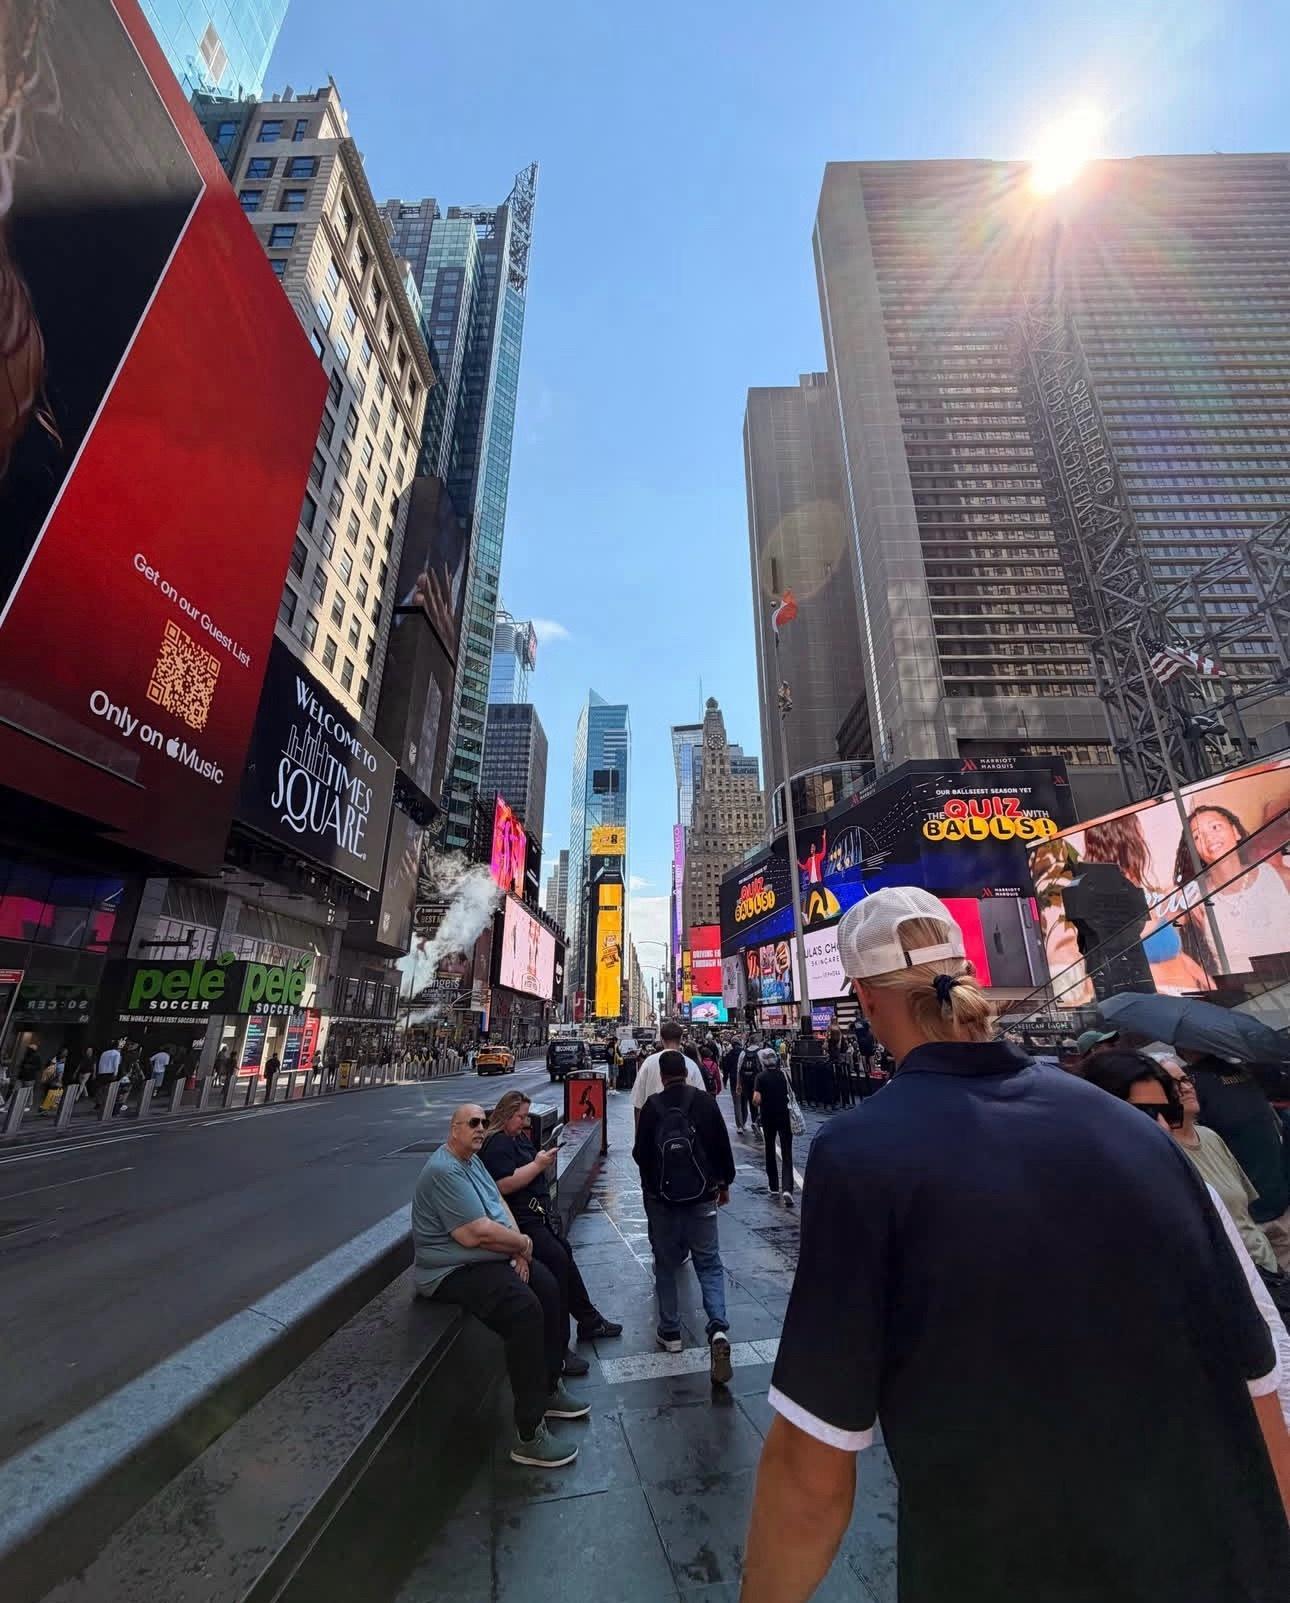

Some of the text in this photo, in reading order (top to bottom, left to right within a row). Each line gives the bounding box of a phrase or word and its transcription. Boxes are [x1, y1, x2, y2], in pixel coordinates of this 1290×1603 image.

[134, 553, 251, 668] Get on our Guest List
[89, 690, 224, 784] Only on Music
[296, 676, 377, 773] WELCOME TO
[326, 754, 373, 815] TIMES
[271, 757, 367, 860] SQUARE
[927, 796, 1050, 820] THE QUIZ WITH
[924, 815, 1056, 839] BALLS!
[740, 876, 764, 900] QUIZ
[735, 890, 776, 922] BALLS!
[803, 945, 823, 958] ULA'S
[128, 951, 236, 1010] pelé
[238, 952, 313, 1013] pelé
[130, 1015, 153, 1023] WORLD'S
[149, 1000, 210, 1010] SOCCER
[256, 1003, 295, 1016] SOCCER
